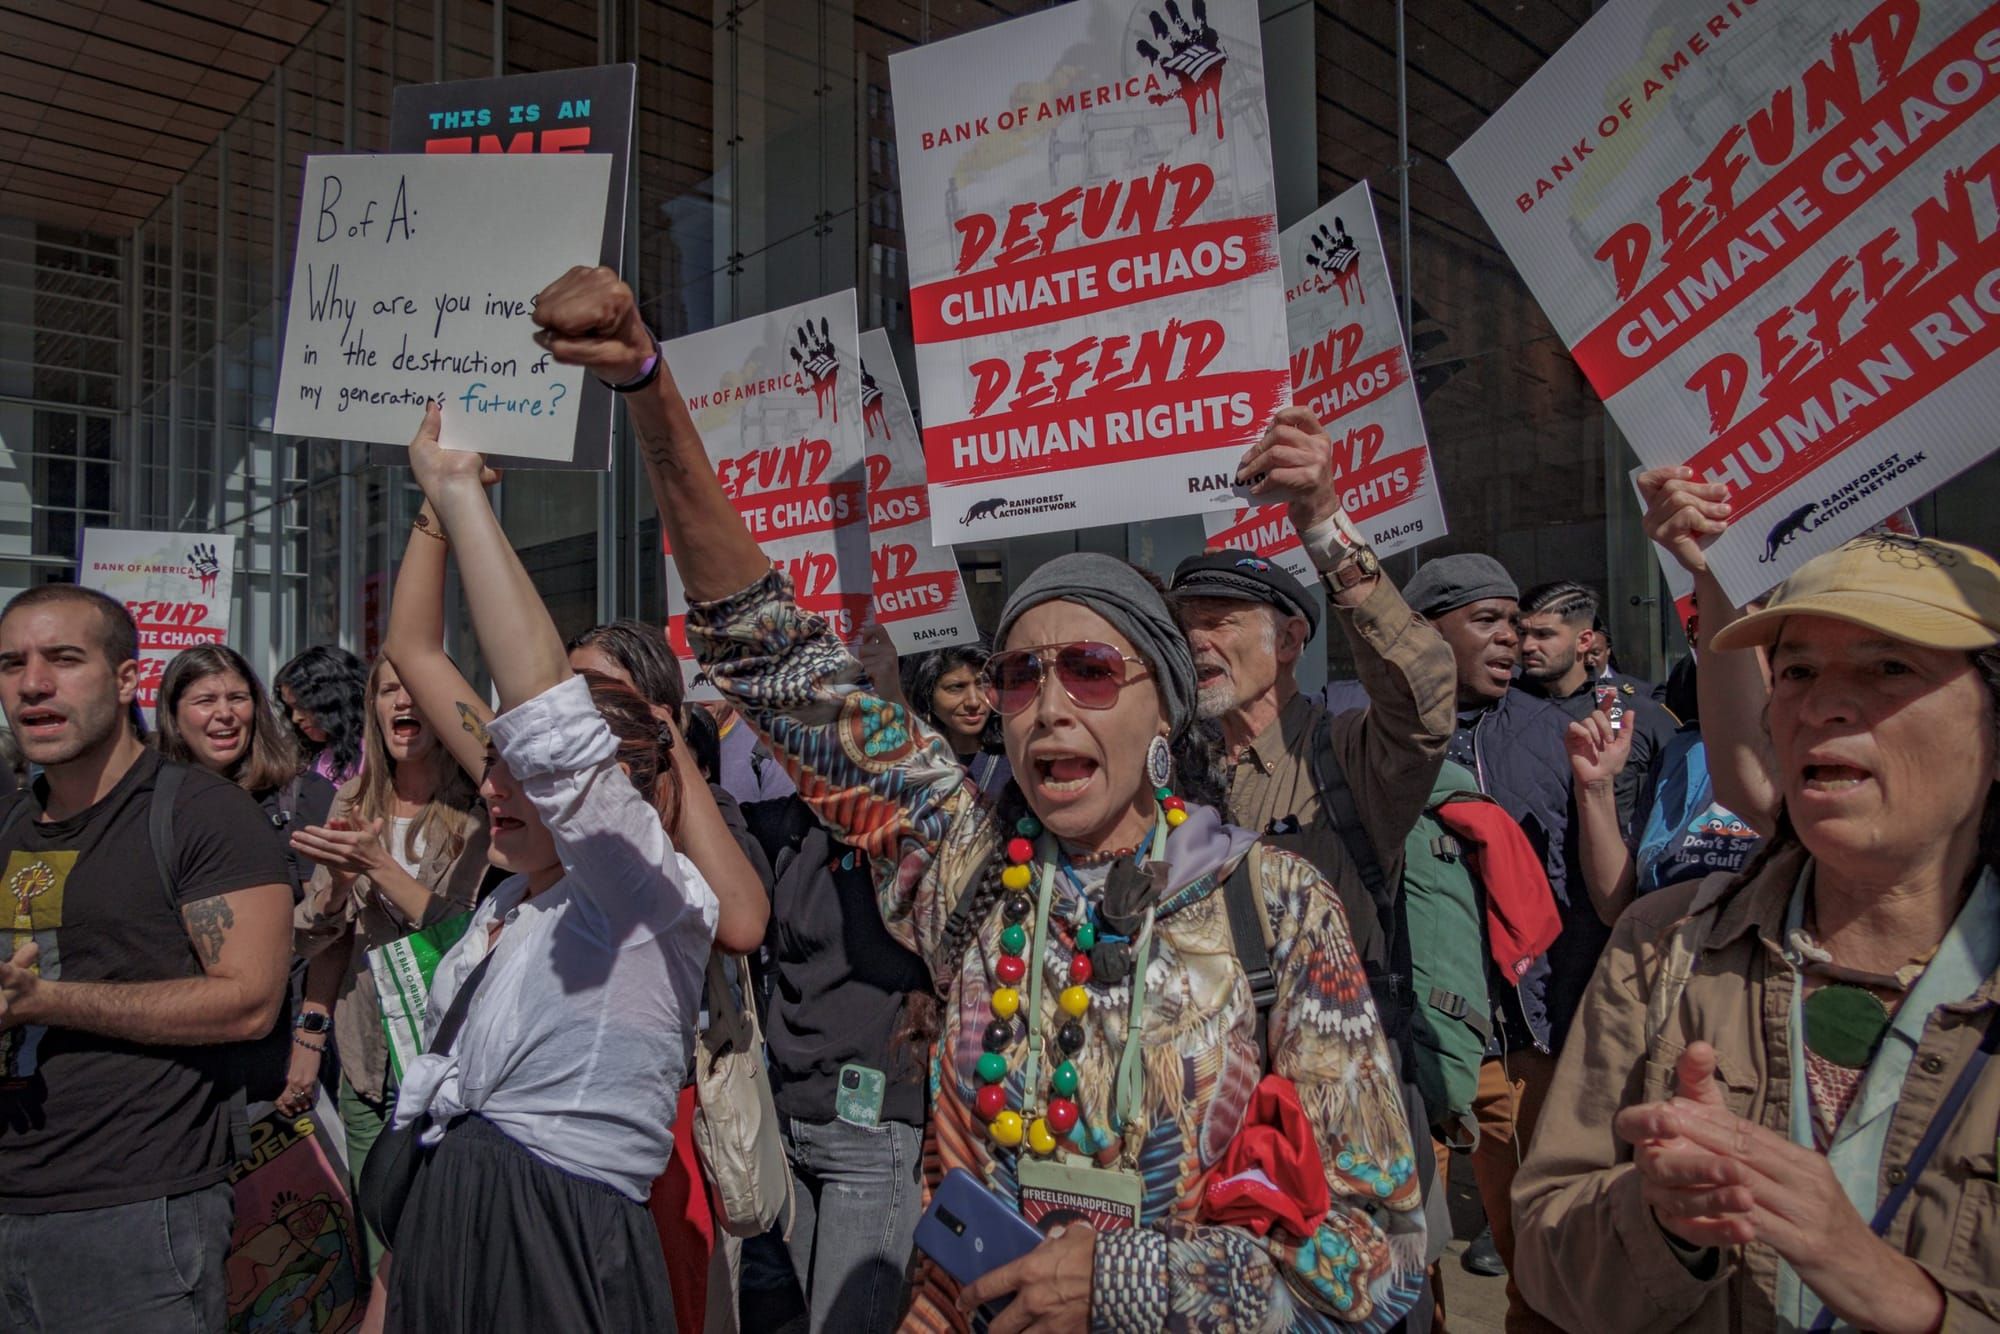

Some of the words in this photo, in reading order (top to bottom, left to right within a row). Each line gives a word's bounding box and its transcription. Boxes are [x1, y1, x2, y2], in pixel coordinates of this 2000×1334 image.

[429, 108, 492, 130] THIS
[509, 104, 541, 124] IS
[557, 99, 591, 120] AN
[921, 116, 990, 151] BANK
[997, 107, 1029, 130] OF
[1036, 72, 1162, 121] AMERICA
[1515, 137, 1595, 214] BANK
[1596, 99, 1635, 138] OF
[1643, 0, 1758, 101] AMERI
[1594, 0, 1920, 302] DEFUND
[316, 175, 343, 243] B
[348, 201, 377, 238] of
[386, 174, 418, 244] A:
[953, 162, 1215, 275] DEFUND
[940, 263, 1099, 326] CLIMATE
[1106, 235, 1248, 294] CHAOS
[1286, 274, 1324, 303] RICA
[1616, 188, 1824, 359] CLIMATE
[308, 263, 356, 346] Why
[373, 299, 417, 316] are
[434, 293, 470, 338] you
[303, 344, 317, 365] in
[341, 329, 377, 367] the
[392, 333, 517, 377] destruction
[530, 353, 553, 375] of
[967, 317, 1226, 418] DEFEND
[1289, 323, 1364, 390] UND
[300, 384, 322, 410] my
[459, 382, 567, 417] future?
[689, 395, 709, 411] NK
[712, 389, 731, 405] OF
[734, 371, 804, 400] AMERICA
[1308, 364, 1390, 418] CHAOS
[951, 415, 1097, 470] HUMAN
[1105, 391, 1255, 446] RIGHTS
[1702, 343, 1916, 500] HUMAN
[717, 436, 832, 499] EFUND
[1342, 467, 1409, 513] GHTS
[1812, 490, 1862, 530] ACTION
[1858, 450, 1928, 501] NETWORK
[1820, 452, 1902, 509] RAINFOREST
[772, 494, 849, 529] CHAOS
[868, 495, 921, 526] AOS
[999, 508, 1031, 519] ACTION
[1032, 501, 1077, 515] NETWORK
[1009, 493, 1064, 508] RAINFOREST
[1225, 515, 1297, 552] HUMA
[1373, 519, 1424, 545] RAN.org
[93, 562, 124, 572] BANK
[127, 564, 141, 573] OF
[143, 565, 195, 575] AMERICA
[874, 583, 943, 615] IGHTS
[161, 632, 216, 646] CHAOS
[913, 626, 958, 641] RAN.org
[1674, 848, 1700, 864] the
[1703, 852, 1743, 868] Gulf
[1682, 835, 1724, 850] Don't
[410, 983, 424, 1010] REUSE
[228, 1117, 315, 1185] FUELS
[1022, 1187, 1133, 1218] #FREELEONARDPELTIER
